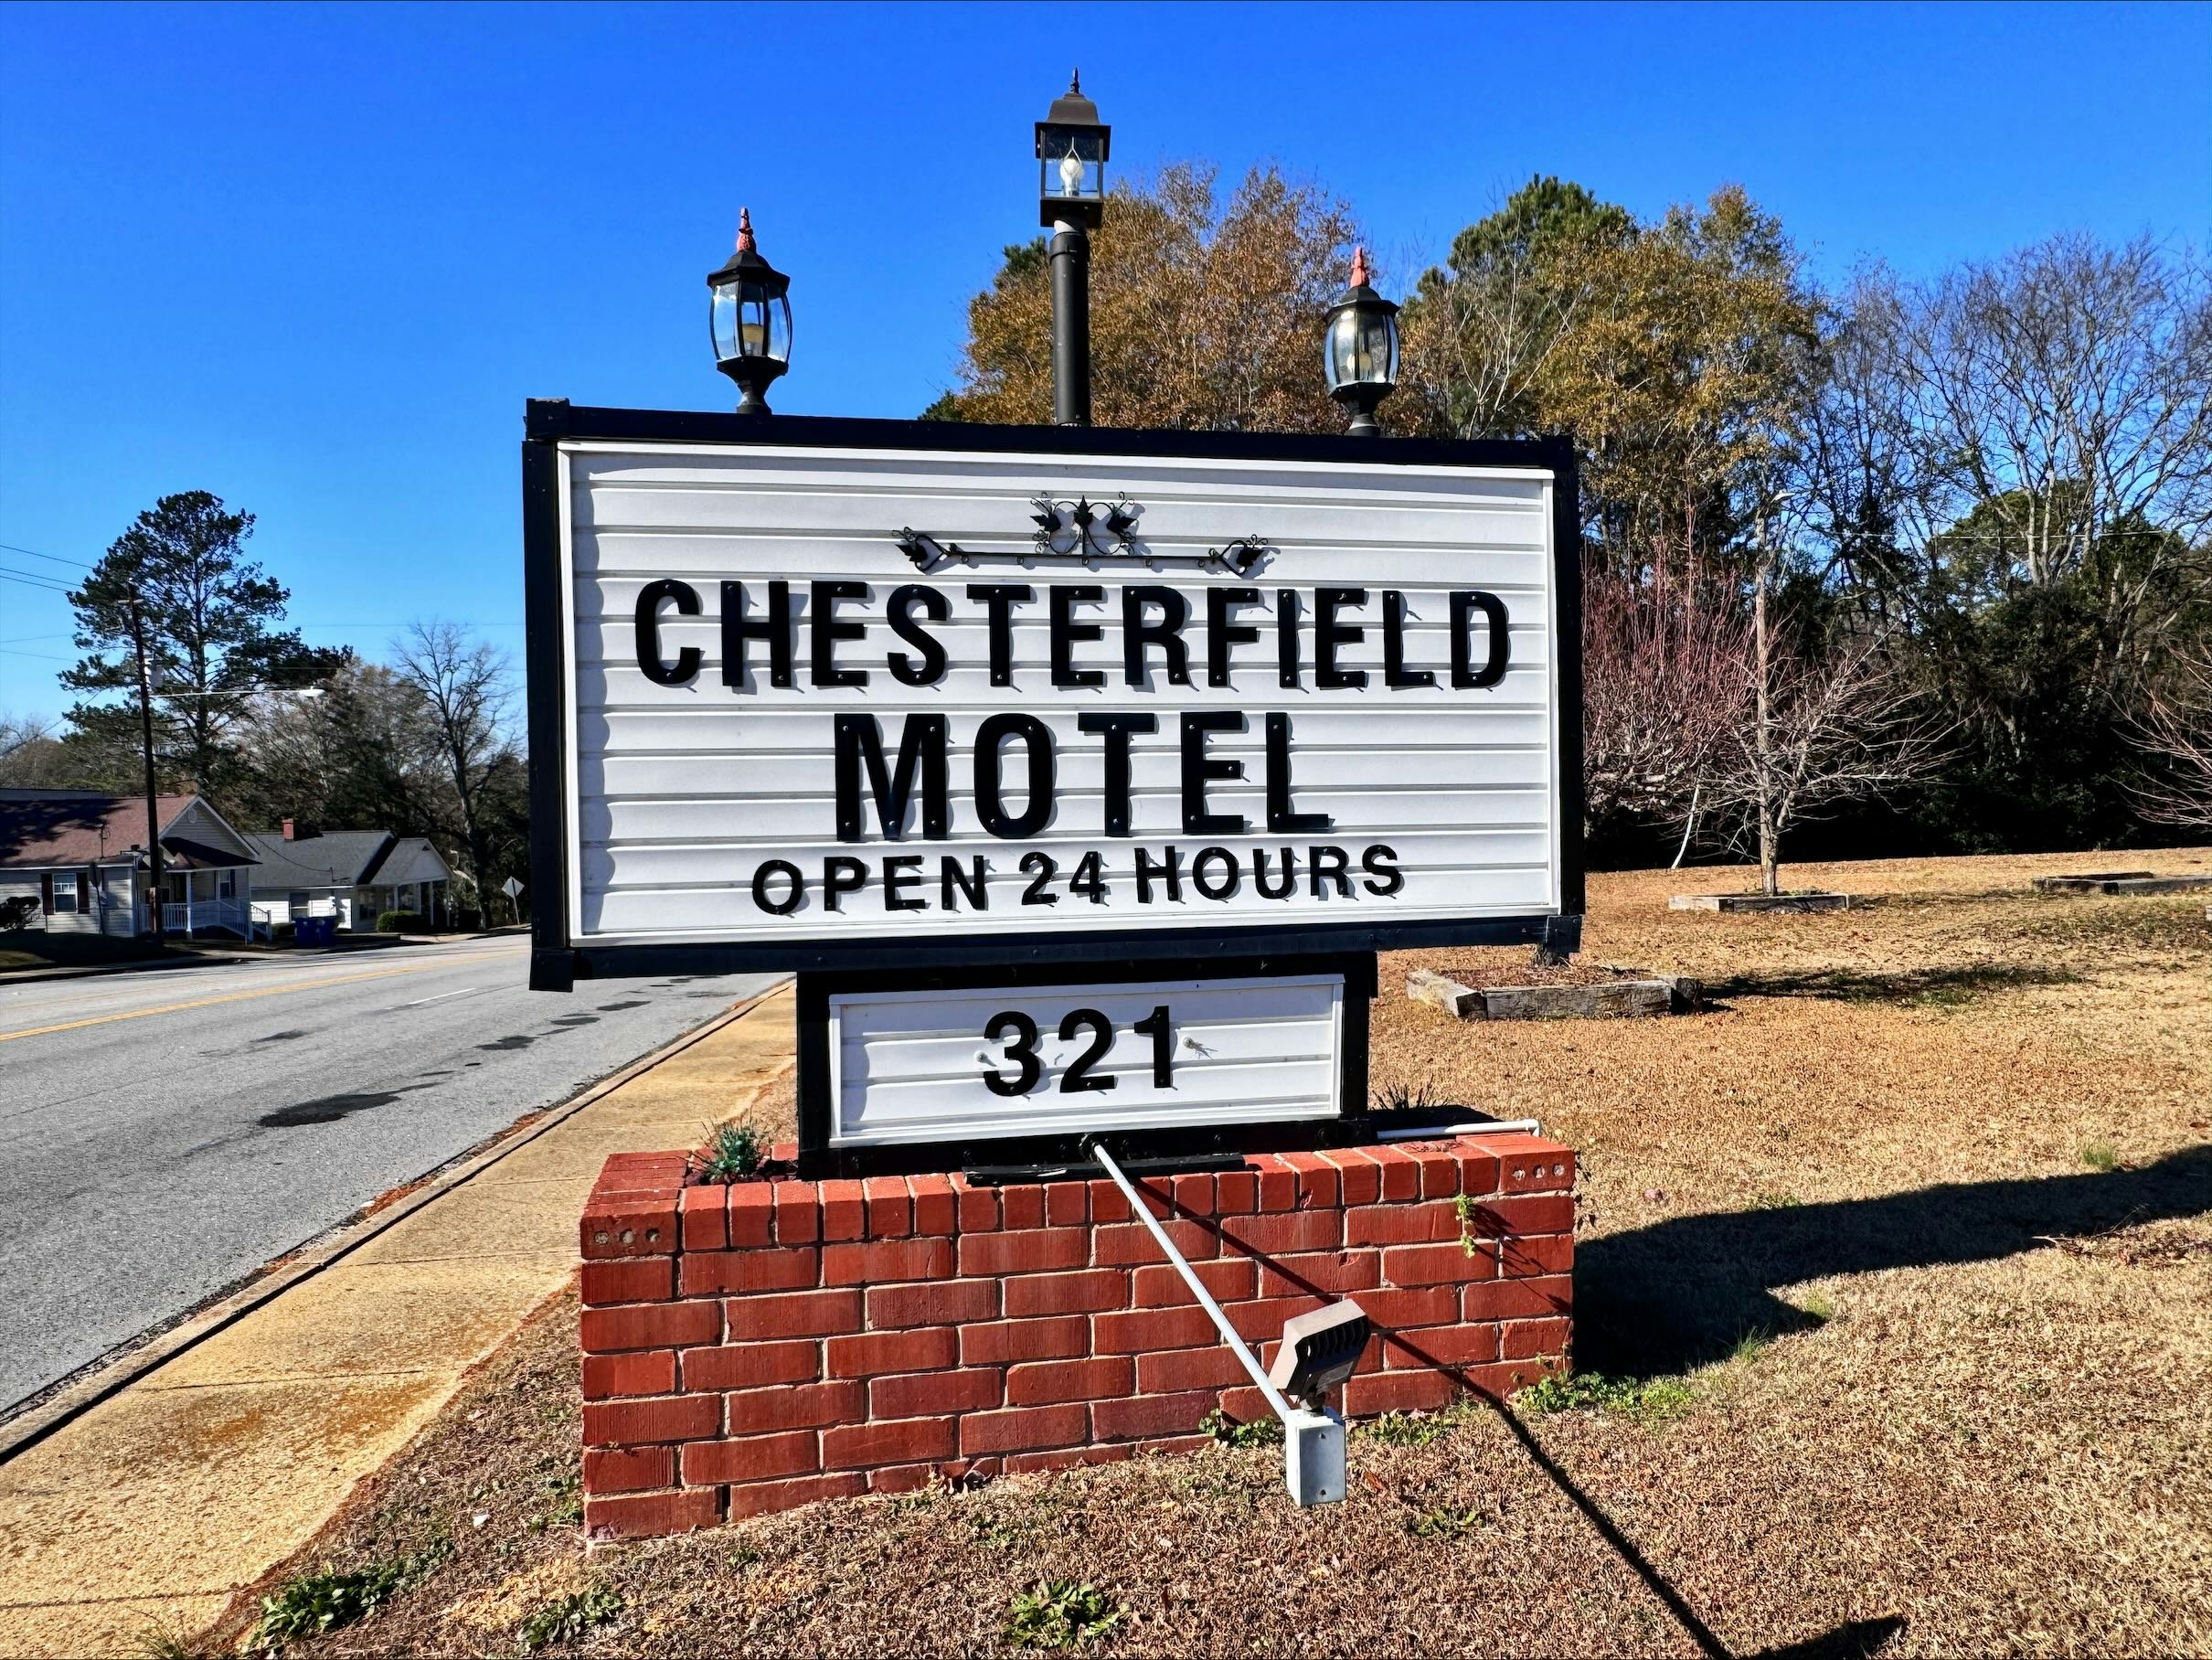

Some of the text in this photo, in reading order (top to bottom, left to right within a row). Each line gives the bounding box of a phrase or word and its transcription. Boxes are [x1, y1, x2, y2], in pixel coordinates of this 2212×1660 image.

[634, 578, 1508, 691] CHESTERFIELD
[834, 710, 1329, 841] MOTEL
[751, 844, 1402, 915] OPEN 24 HOURS
[983, 1005, 1174, 1097] 321
